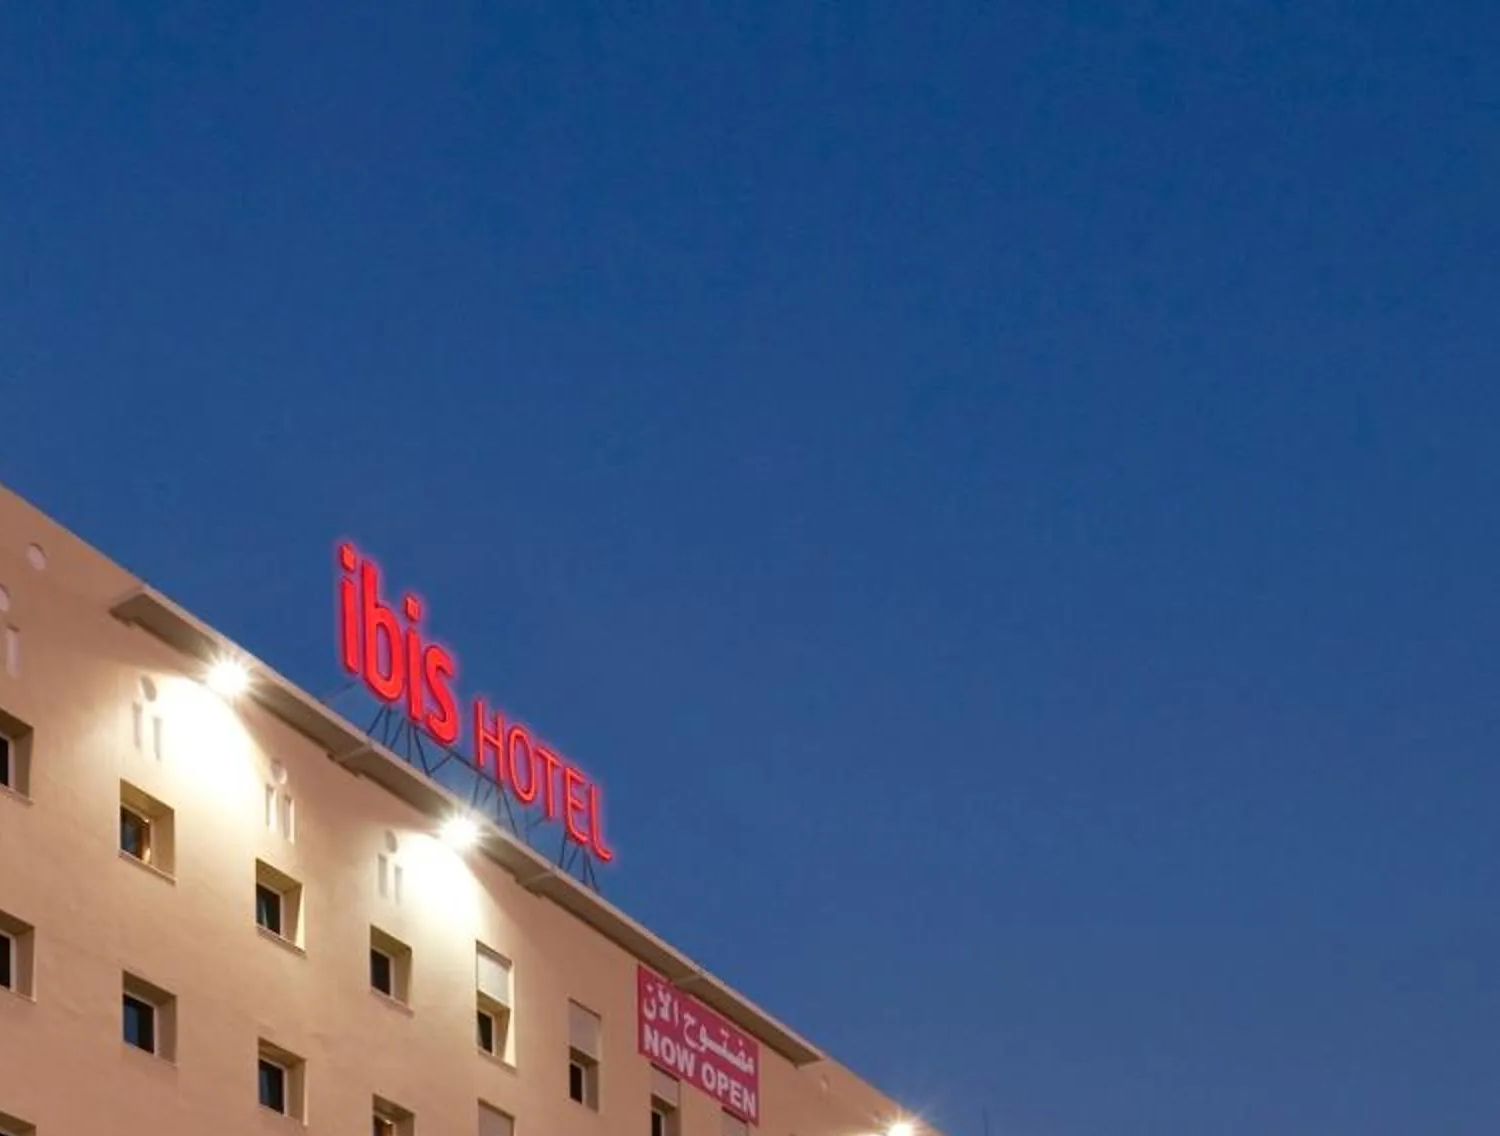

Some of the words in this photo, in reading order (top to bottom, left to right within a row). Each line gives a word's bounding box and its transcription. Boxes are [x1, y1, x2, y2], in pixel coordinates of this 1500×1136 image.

[340, 543, 457, 744] ibis
[474, 699, 612, 861] HOTEL
[644, 1023, 696, 1078] NOW
[702, 1061, 757, 1119] OPEN
[682, 1011, 755, 1077] مفتوح
